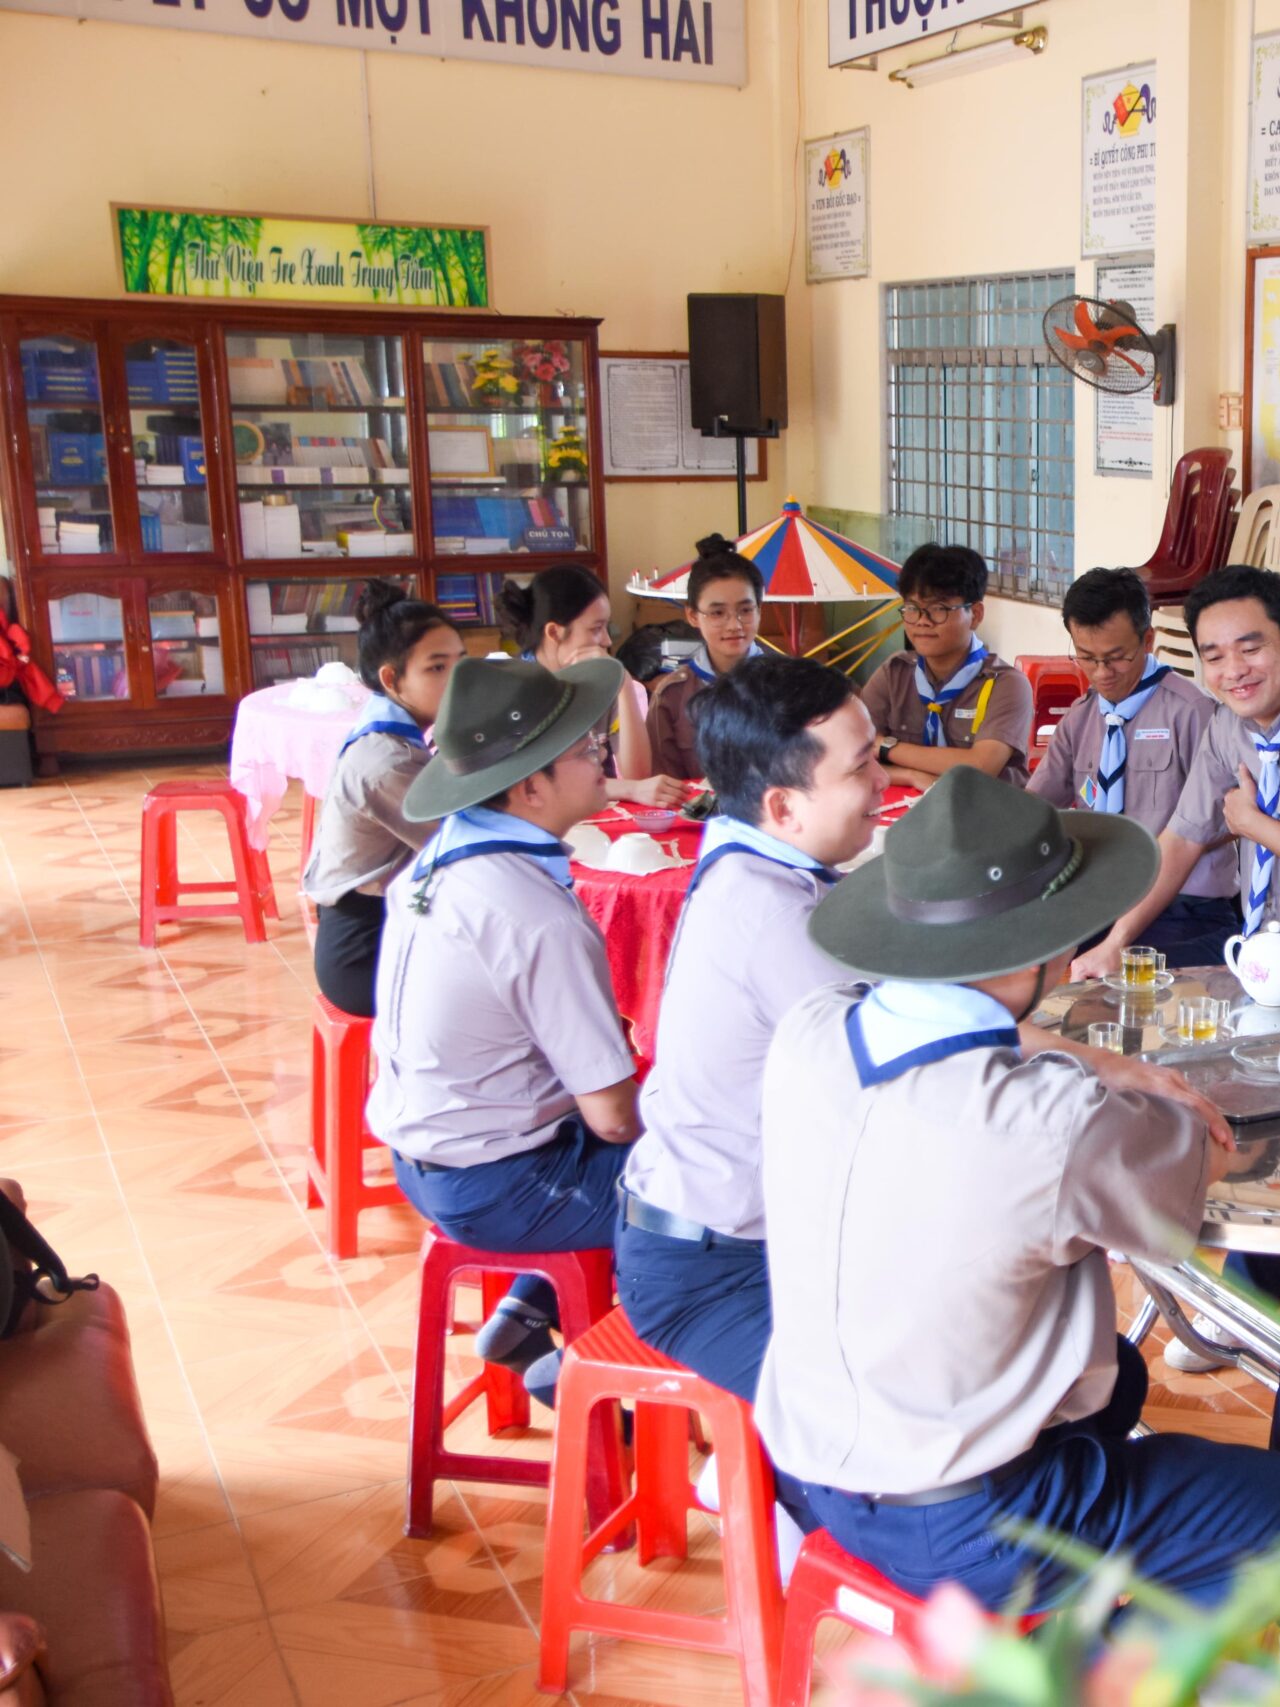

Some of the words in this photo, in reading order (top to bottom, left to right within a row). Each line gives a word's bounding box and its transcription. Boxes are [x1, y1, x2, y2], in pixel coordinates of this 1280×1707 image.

[643, 0, 713, 65] HAI
[184, 242, 219, 282] Thư
[224, 245, 264, 293] Viện
[270, 246, 296, 285] Tre
[302, 248, 344, 288] Xanh
[350, 251, 395, 297] Trung
[399, 253, 433, 290] Tâm
